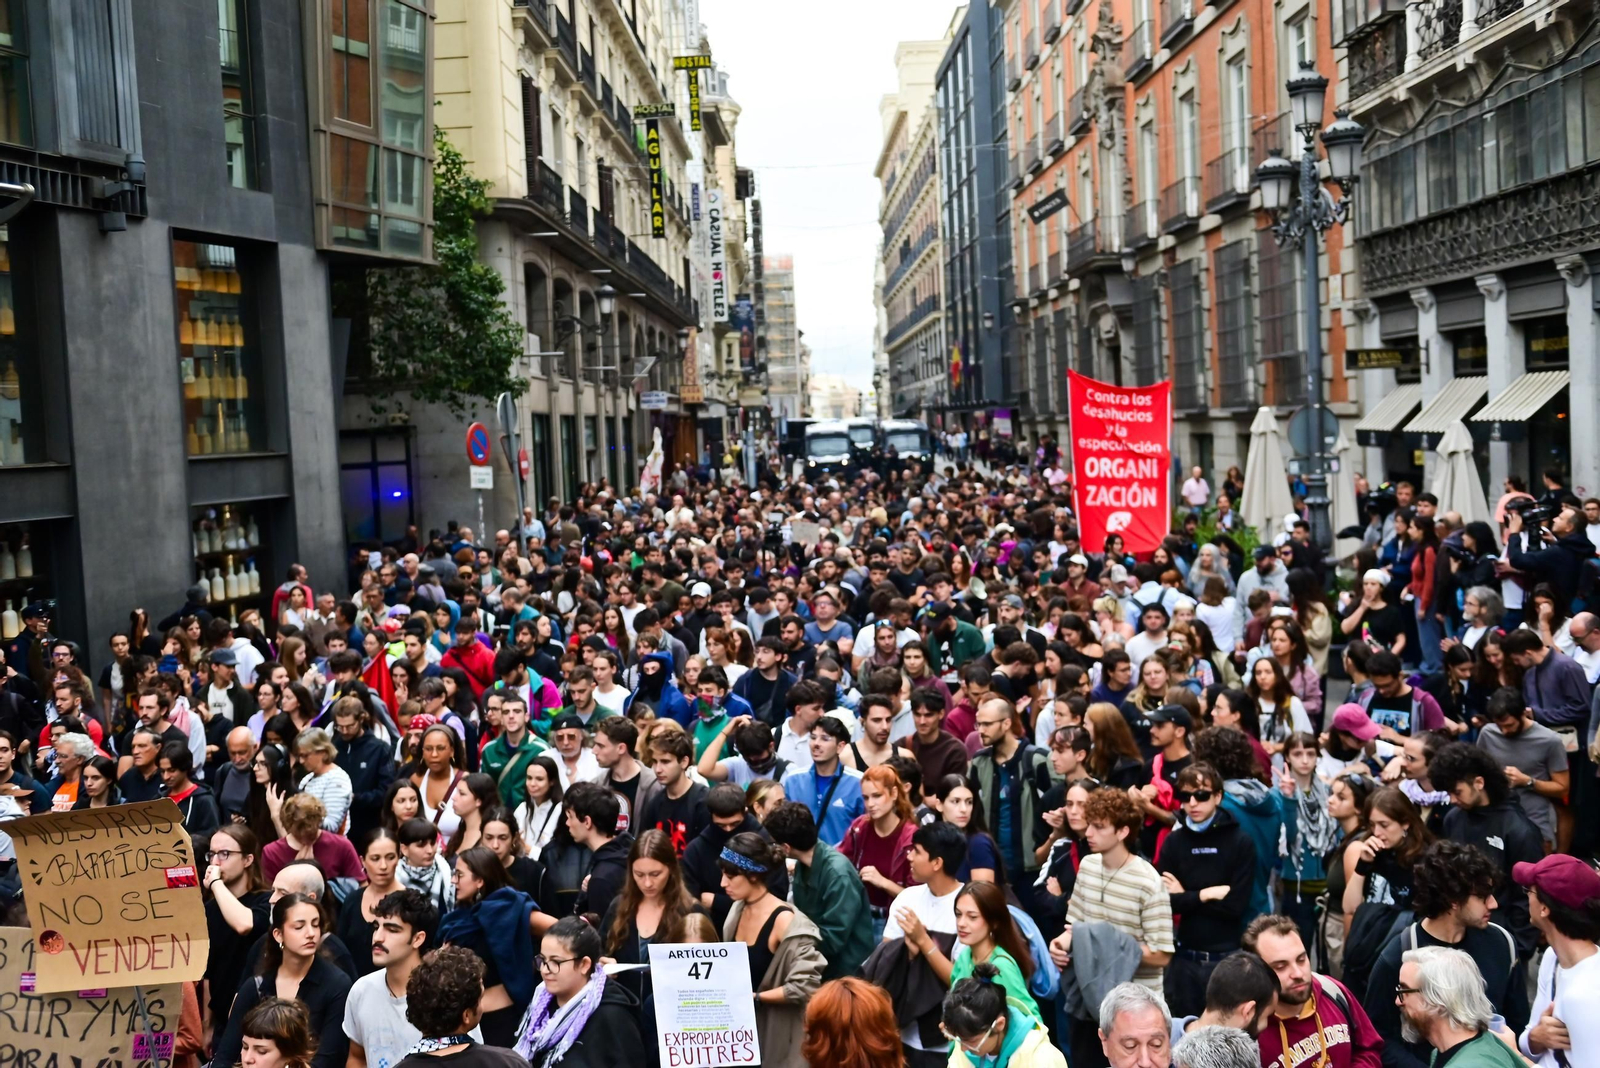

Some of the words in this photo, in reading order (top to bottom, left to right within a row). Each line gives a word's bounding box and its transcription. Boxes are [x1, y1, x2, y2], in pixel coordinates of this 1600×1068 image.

[673, 56, 711, 67] HOSTAL
[689, 70, 700, 124] VICTORIA
[634, 104, 674, 114] HOSTAL
[648, 128, 663, 227] AGUILAR
[709, 208, 722, 257] CASUAL
[1086, 388, 1129, 405] Contra
[1132, 393, 1152, 406] los
[1082, 403, 1153, 423] desahucios
[1105, 424, 1114, 437] y
[1115, 424, 1128, 437] la
[1084, 457, 1158, 478] ORGANI
[1085, 482, 1157, 508] ZACIÓN
[11, 807, 173, 846] NUESTROS
[46, 842, 180, 886] BARRIOS
[40, 894, 103, 928] NO
[120, 887, 174, 921] SE
[68, 932, 190, 976] VENDEN
[668, 947, 728, 959] ARTÍCULO
[688, 962, 713, 980] 47
[664, 1026, 753, 1046] EXPROPIACIÓN
[669, 1042, 754, 1067] BUITRES
